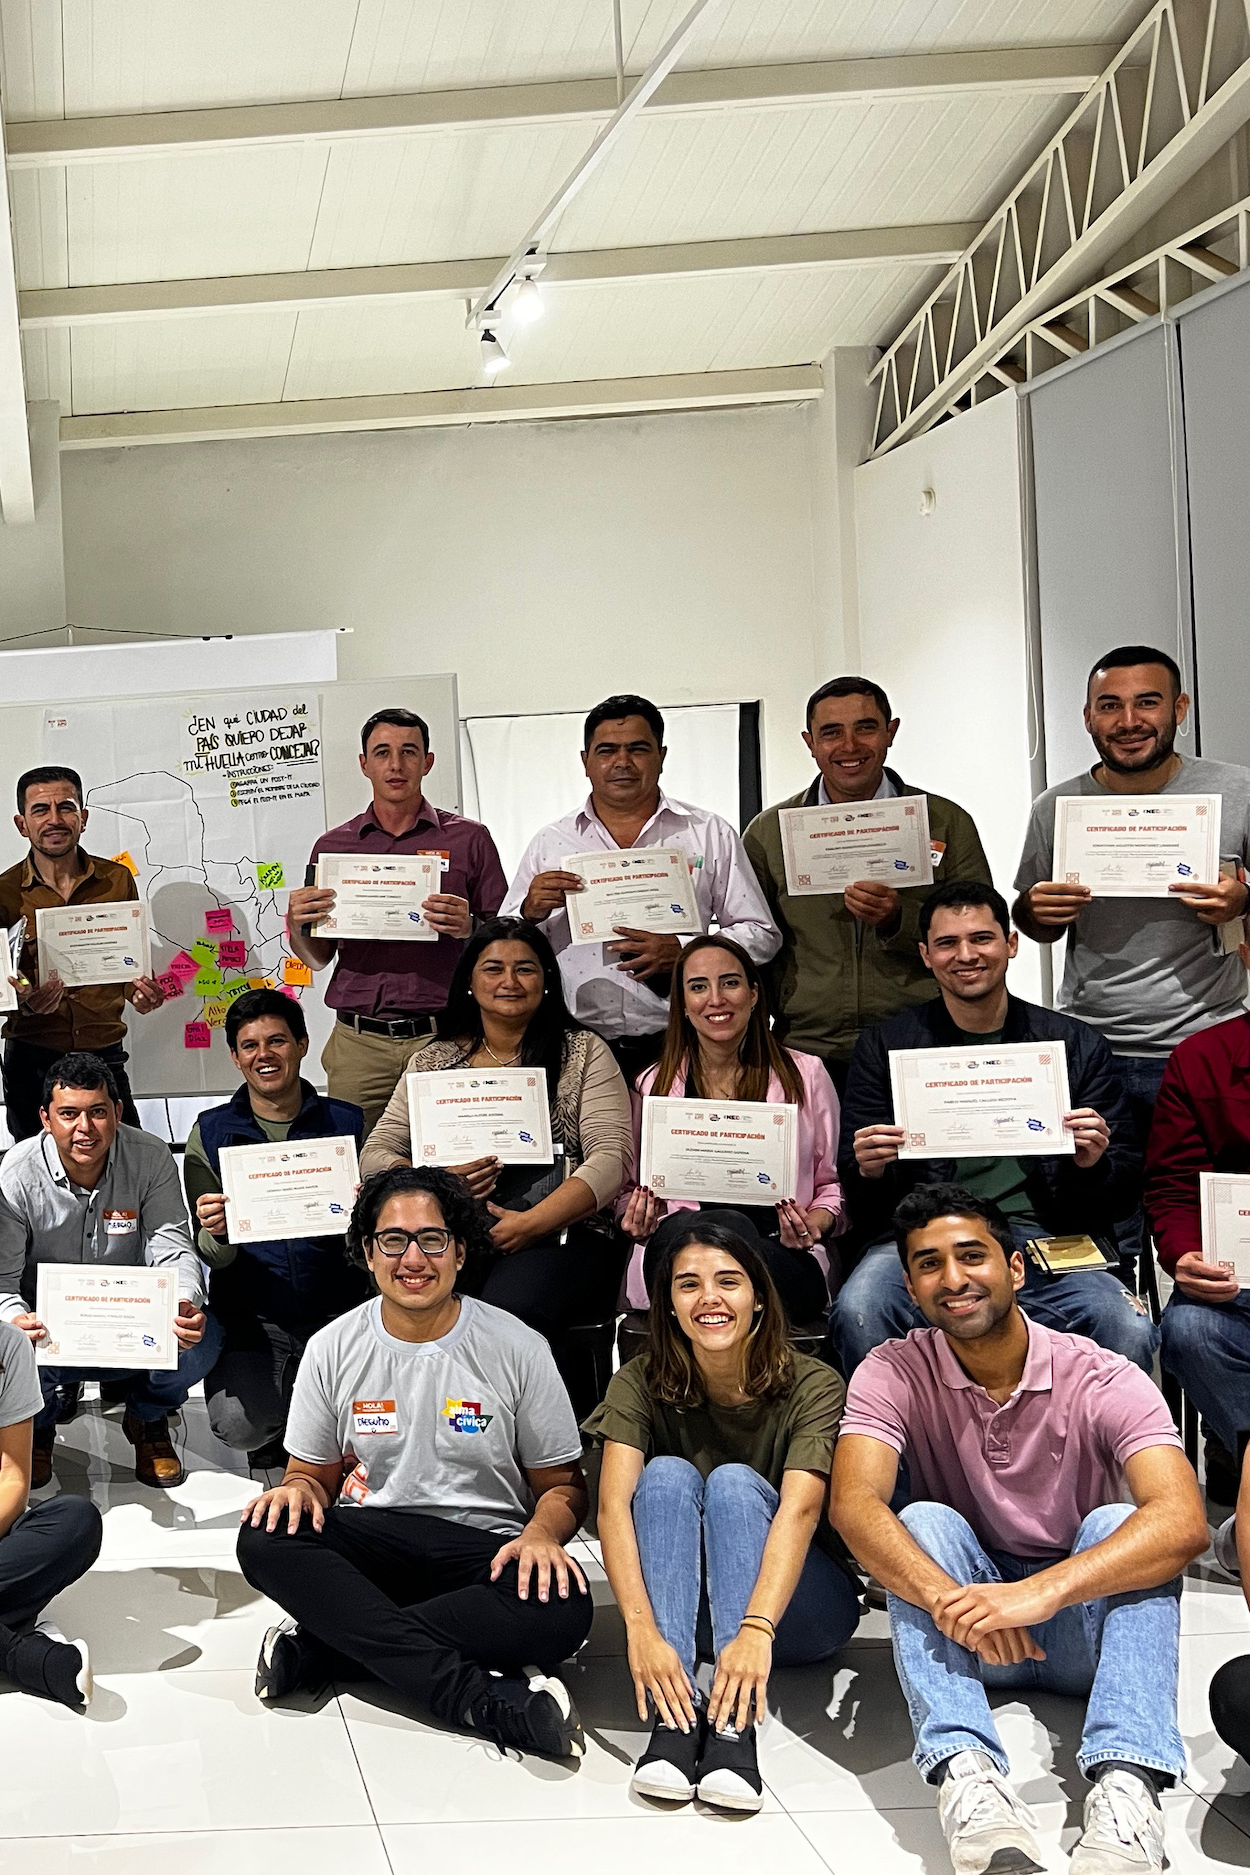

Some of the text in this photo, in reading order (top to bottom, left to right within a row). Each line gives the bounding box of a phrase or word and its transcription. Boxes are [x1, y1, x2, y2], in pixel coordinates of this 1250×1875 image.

[188, 704, 308, 735] ¿EN qué CIUDAD del
[197, 723, 307, 752] PAÍS QUIERO DEJAR
[205, 751, 245, 772] HUELLA
[208, 1007, 226, 1017] Alto
[925, 1080, 967, 1088] CERTIFICADO
[249, 1171, 282, 1179] CERTIFICADO
[448, 1405, 476, 1416] alma
